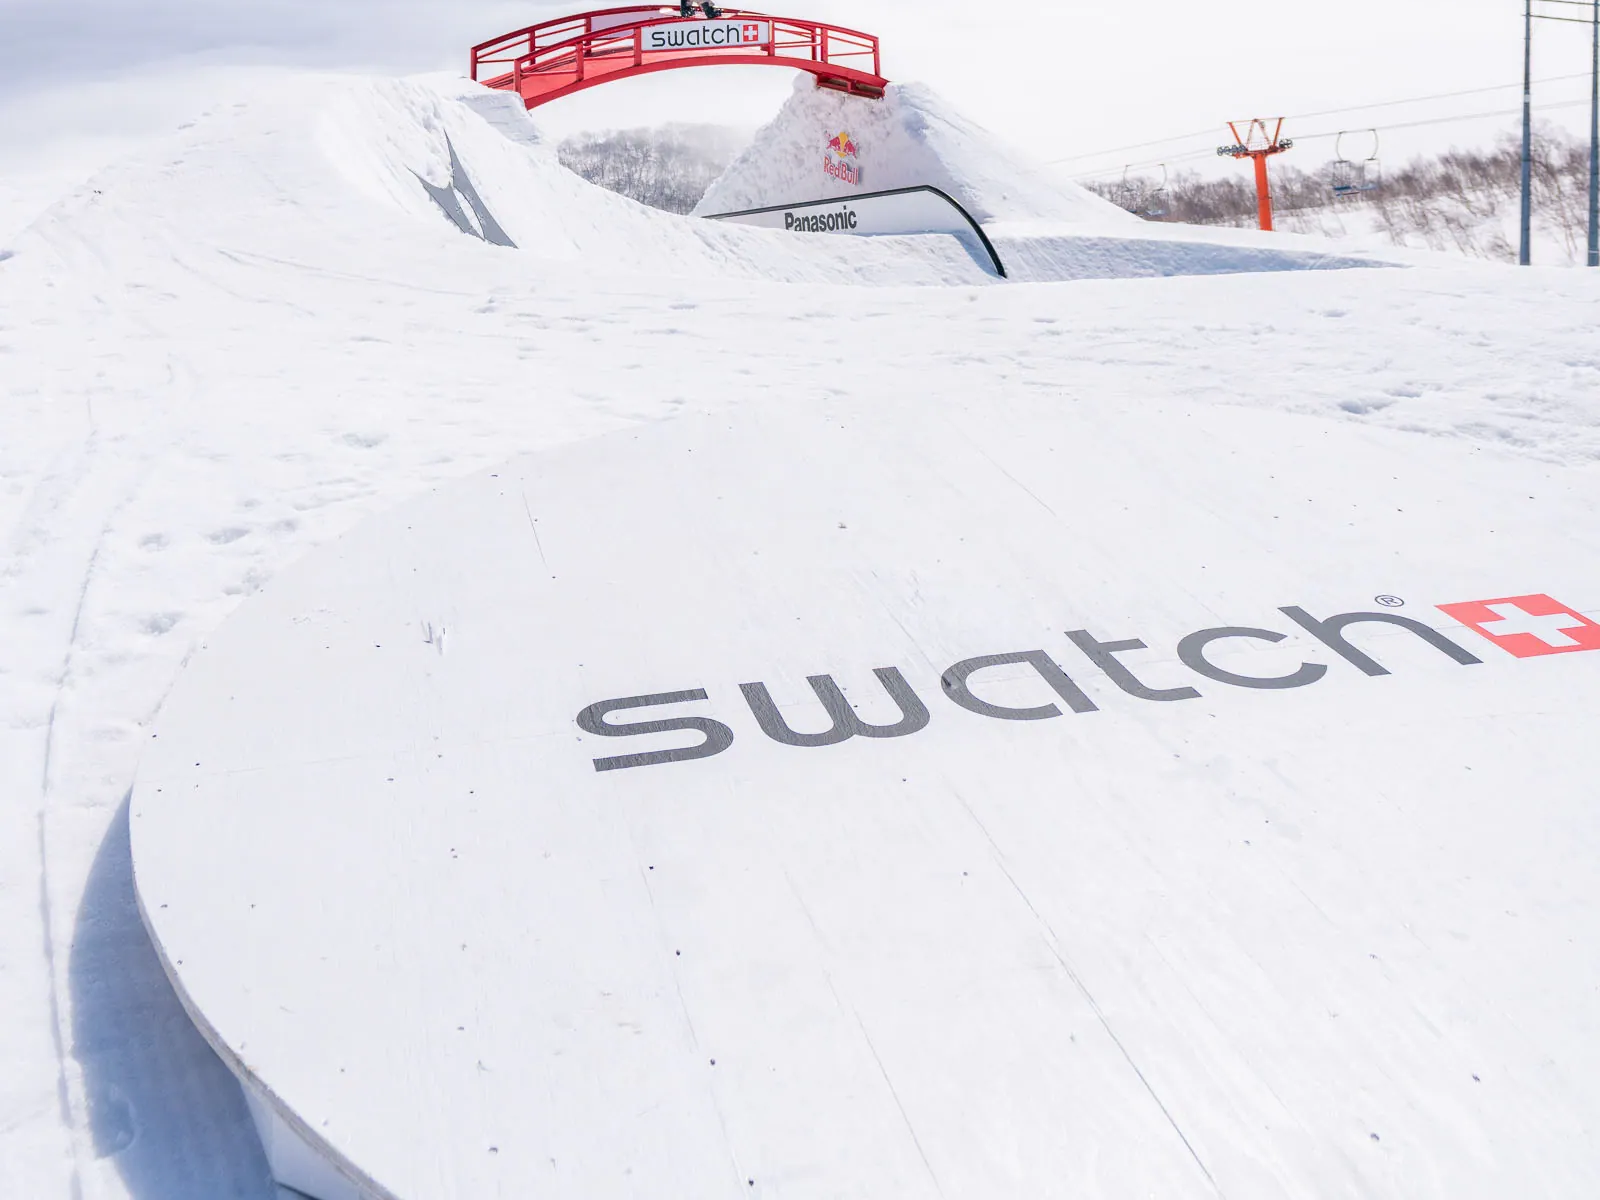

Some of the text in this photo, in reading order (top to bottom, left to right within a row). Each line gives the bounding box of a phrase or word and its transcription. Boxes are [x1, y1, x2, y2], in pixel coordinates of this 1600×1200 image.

[651, 24, 740, 47] swatch
[823, 155, 859, 185] Red Bull
[784, 205, 857, 232] Panasonic
